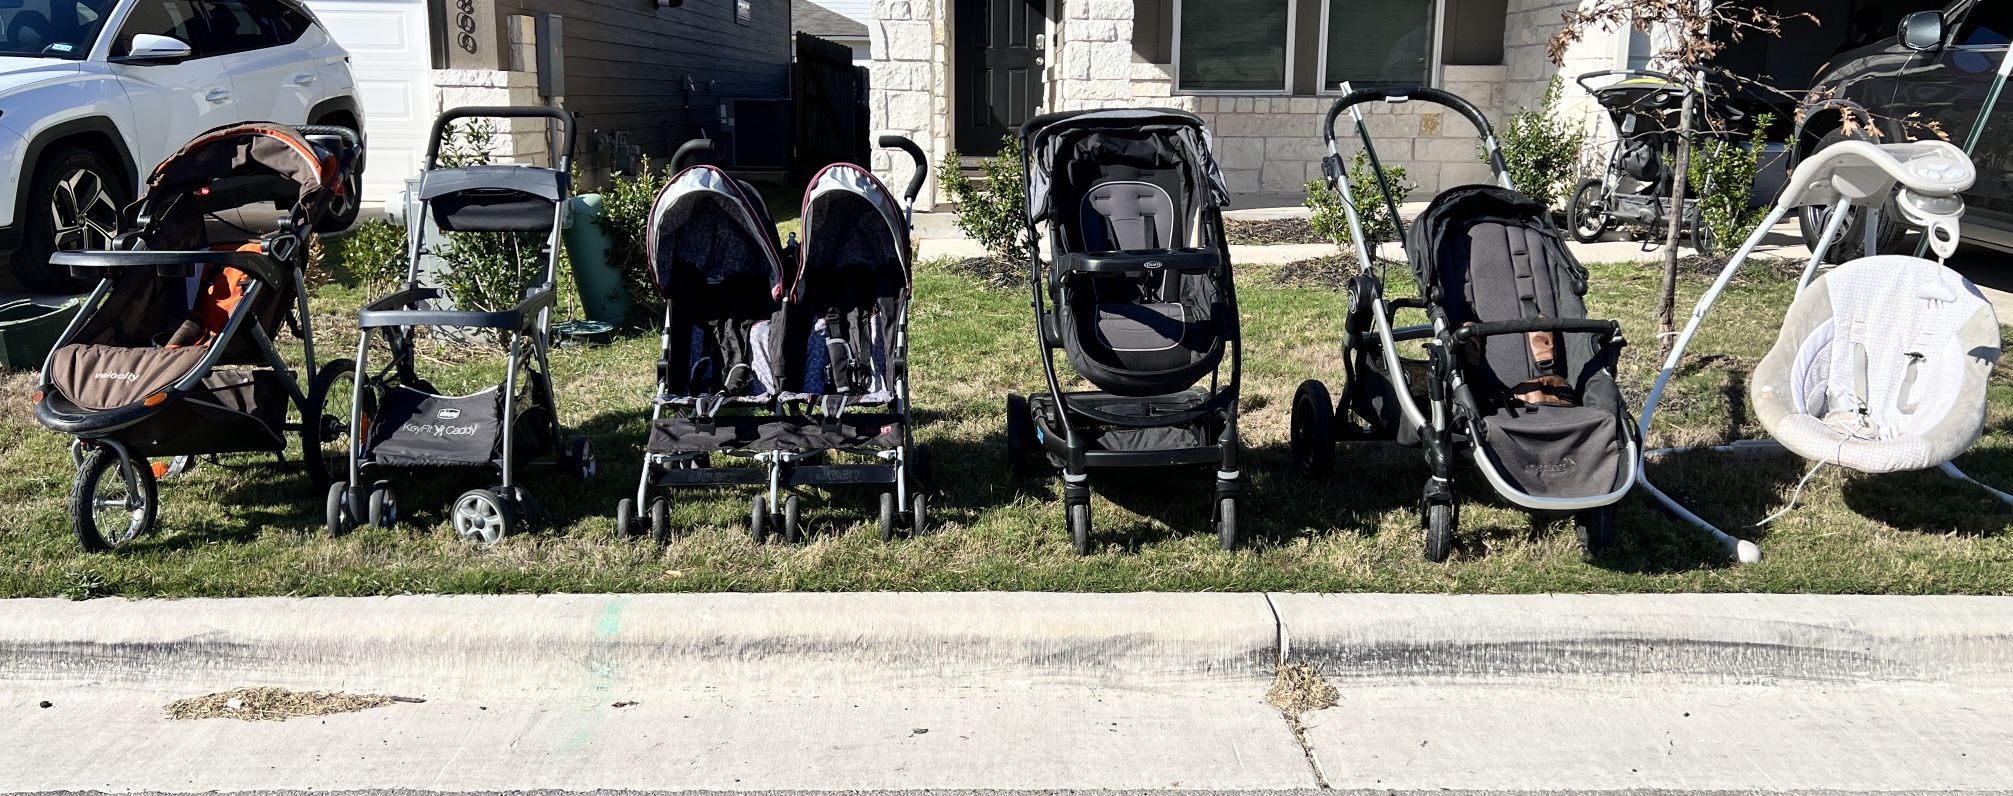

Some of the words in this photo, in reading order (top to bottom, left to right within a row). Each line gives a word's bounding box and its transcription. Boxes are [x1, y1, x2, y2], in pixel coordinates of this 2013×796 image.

[94, 371, 139, 382] velocity
[403, 423, 433, 435] KeyFit
[446, 424, 478, 436] Caddy
